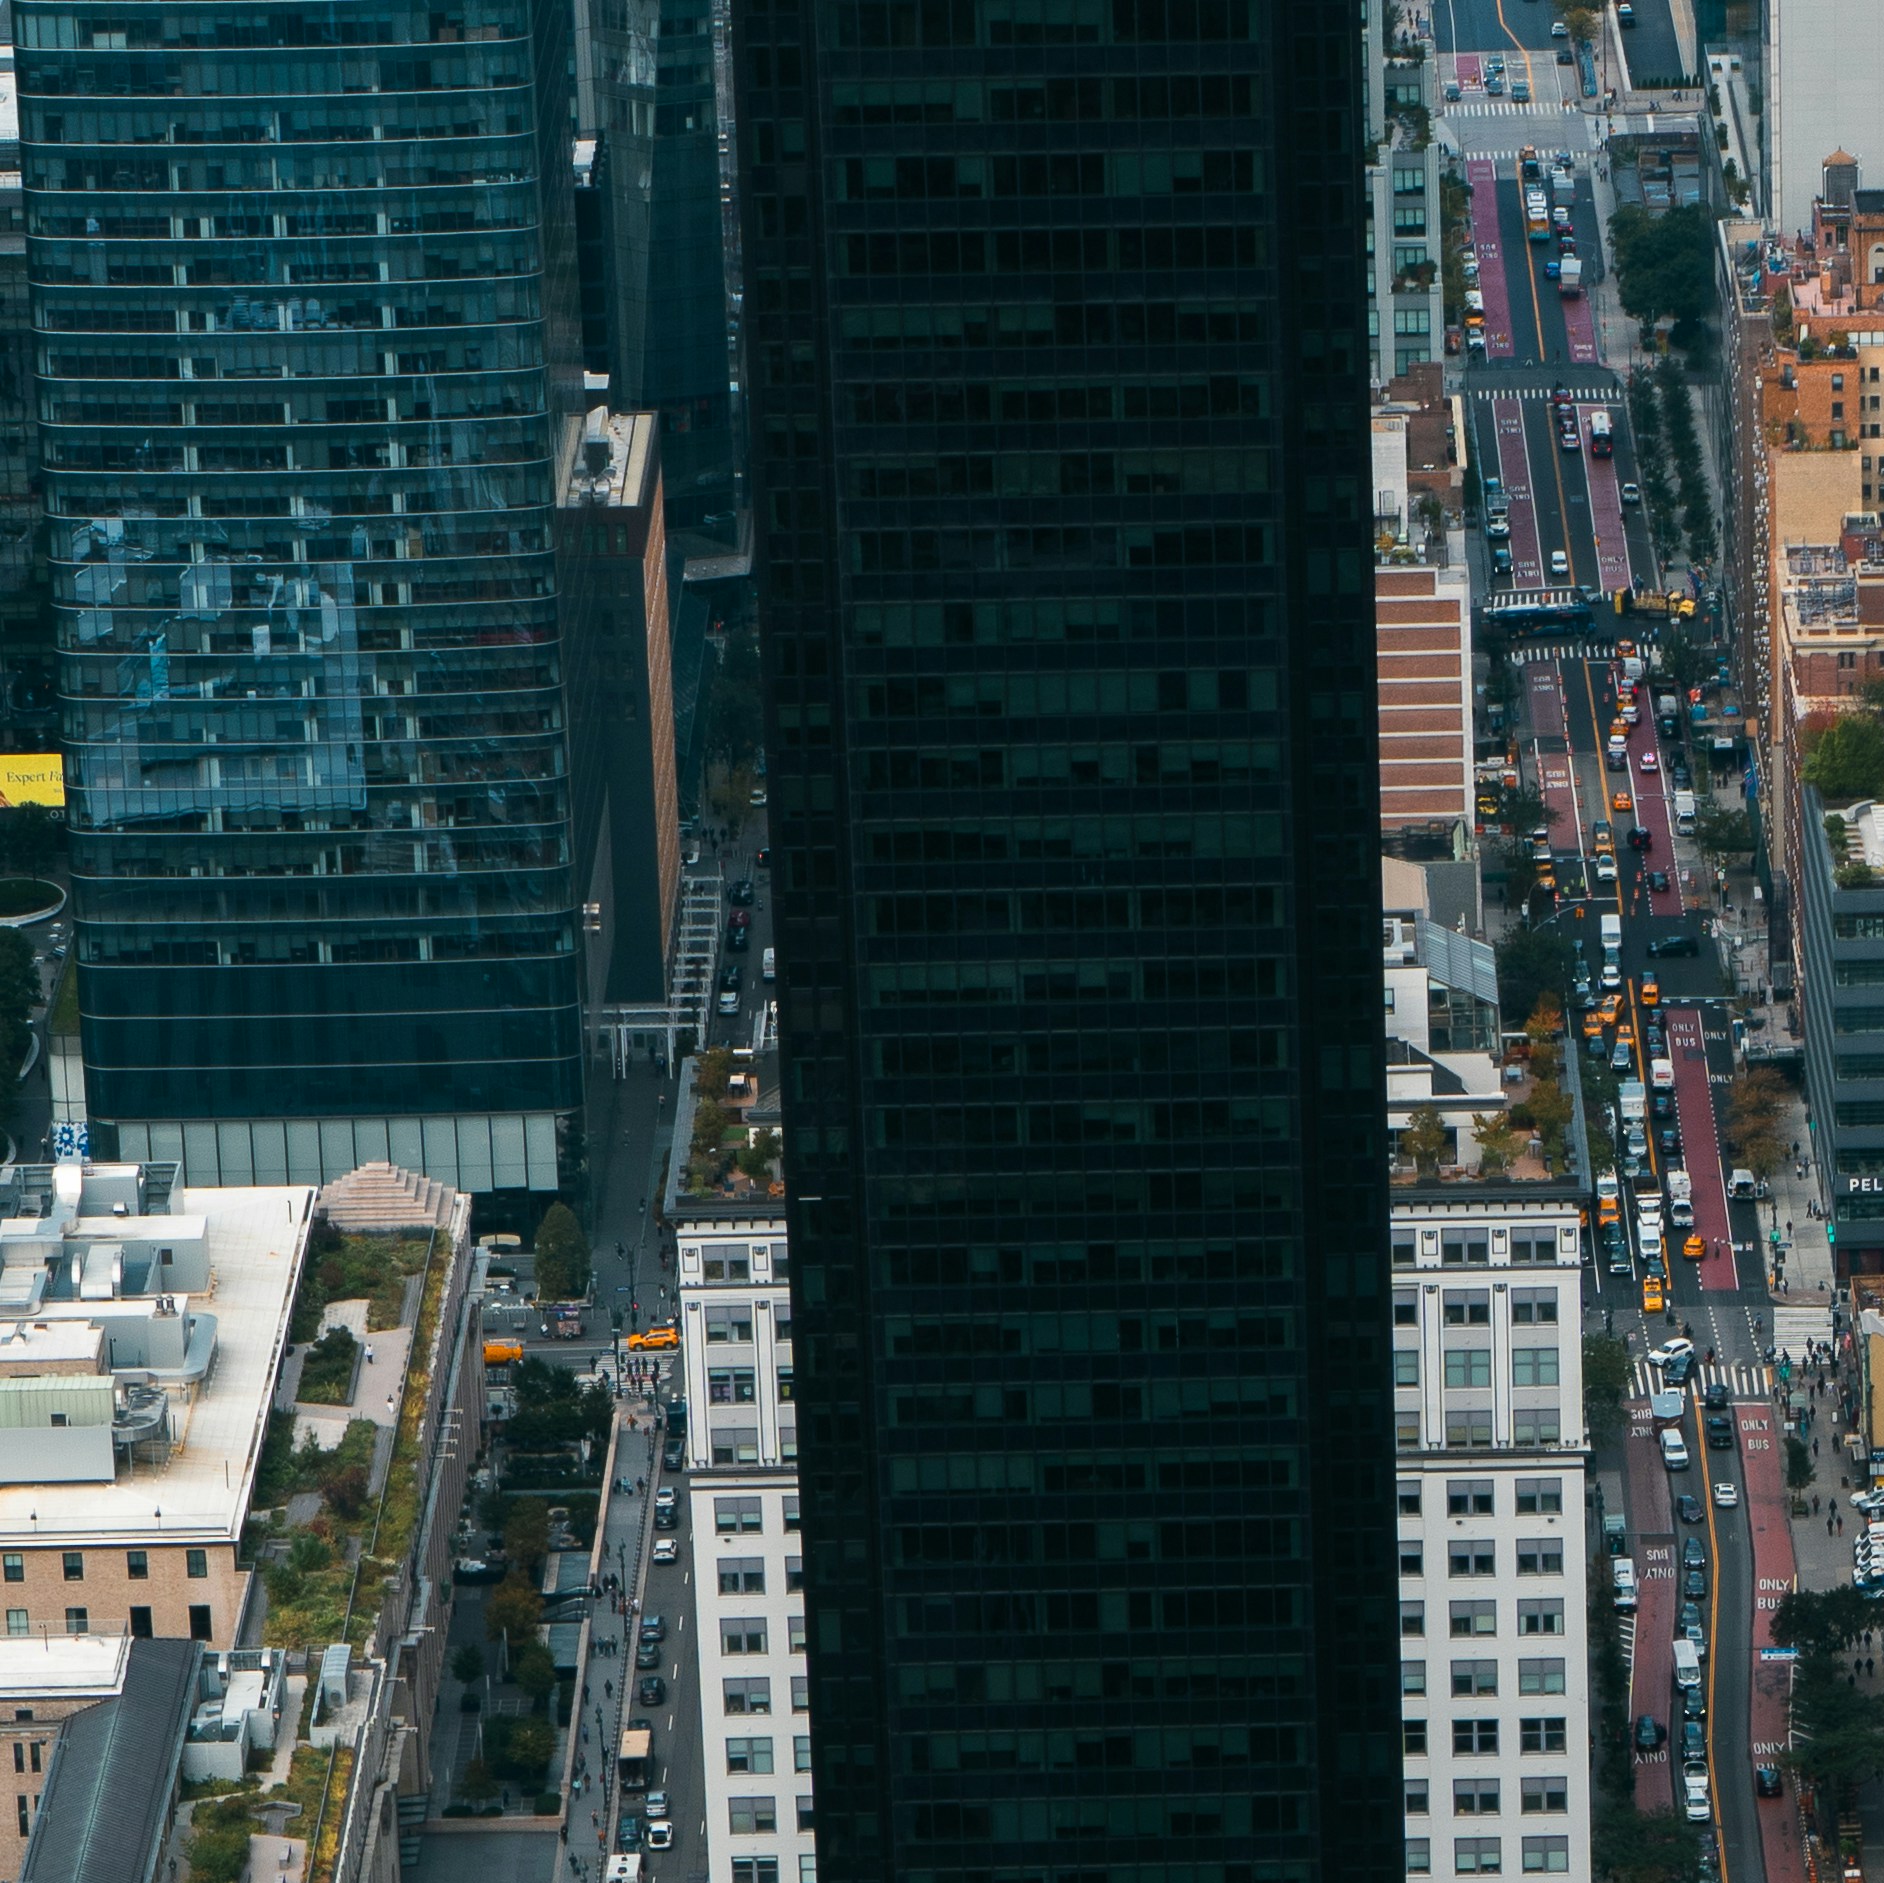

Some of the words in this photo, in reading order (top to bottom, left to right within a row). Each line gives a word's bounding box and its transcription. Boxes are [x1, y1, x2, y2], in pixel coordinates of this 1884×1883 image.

[1601, 556, 1624, 564] ONLY
[7, 771, 45, 786] Expert
[50, 771, 63, 782] Fa
[1672, 1023, 1694, 1033] ONLY
[1704, 1031, 1727, 1040] ONLY
[1675, 1037, 1696, 1047] BUS
[1711, 1074, 1734, 1084] ONLY
[1741, 1419, 1768, 1431] ONLY
[1747, 1438, 1770, 1450] BUS
[1646, 1549, 1668, 1561] BUS
[1644, 1567, 1674, 1580] ONLY
[1759, 1579, 1790, 1592] ONLY
[1753, 1742, 1785, 1755] ONLY
[1634, 1750, 1667, 1765] ONLY
